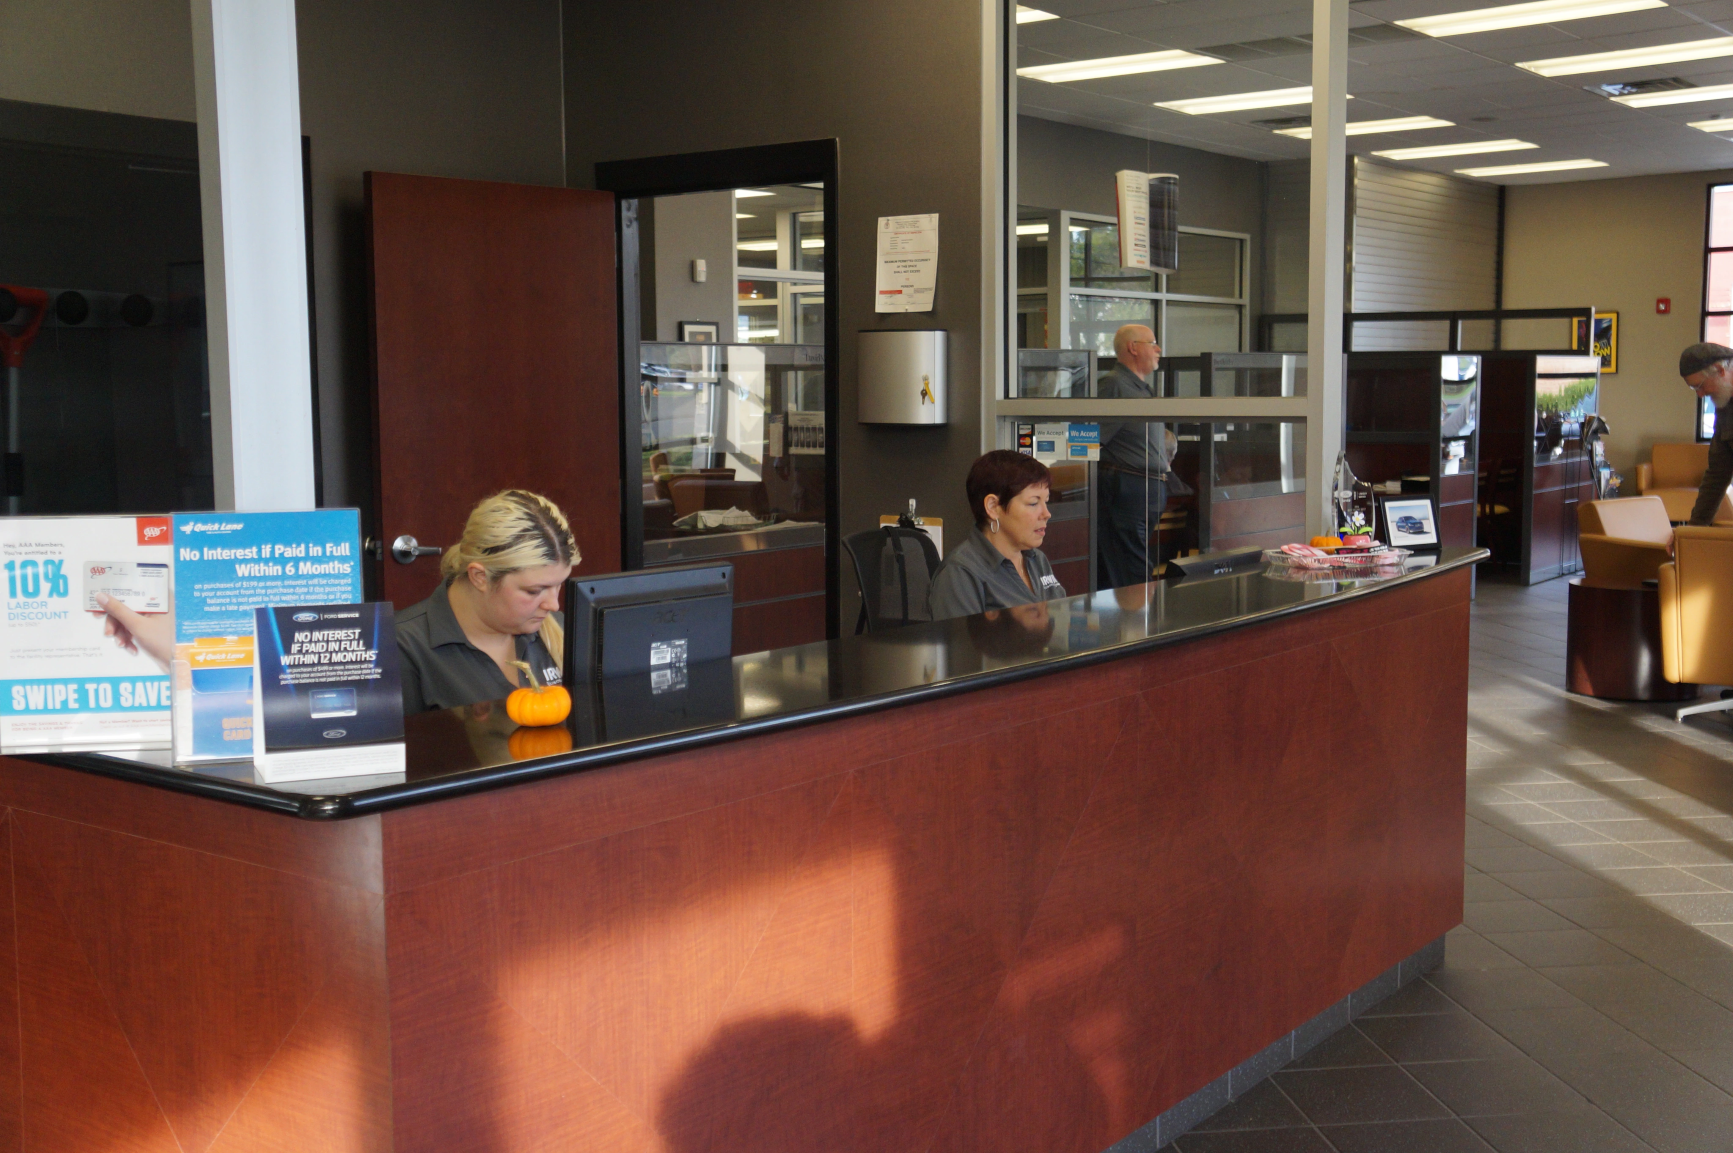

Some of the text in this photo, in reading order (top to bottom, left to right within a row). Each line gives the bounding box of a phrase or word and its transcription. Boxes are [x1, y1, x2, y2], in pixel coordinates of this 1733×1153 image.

[194, 522, 244, 532] Quick Lane
[179, 542, 350, 561] No Interest if Paid in Full
[235, 562, 282, 578] Within
[284, 562, 295, 576] 6
[3, 558, 69, 599] 10%
[203, 582, 234, 590] purchases
[7, 601, 48, 610] LABOR
[8, 610, 70, 620] DISCOUNT
[653, 608, 688, 623] acer
[294, 628, 362, 642] NO INTEREST
[291, 640, 366, 654] IF PAID IN FULL
[206, 652, 226, 660] Quick
[280, 654, 318, 666] WITHIN
[320, 652, 330, 664] 12
[12, 682, 171, 710] SWIPE TO SAVE
[222, 717, 253, 730] QUICK
[223, 729, 252, 742] CARD
